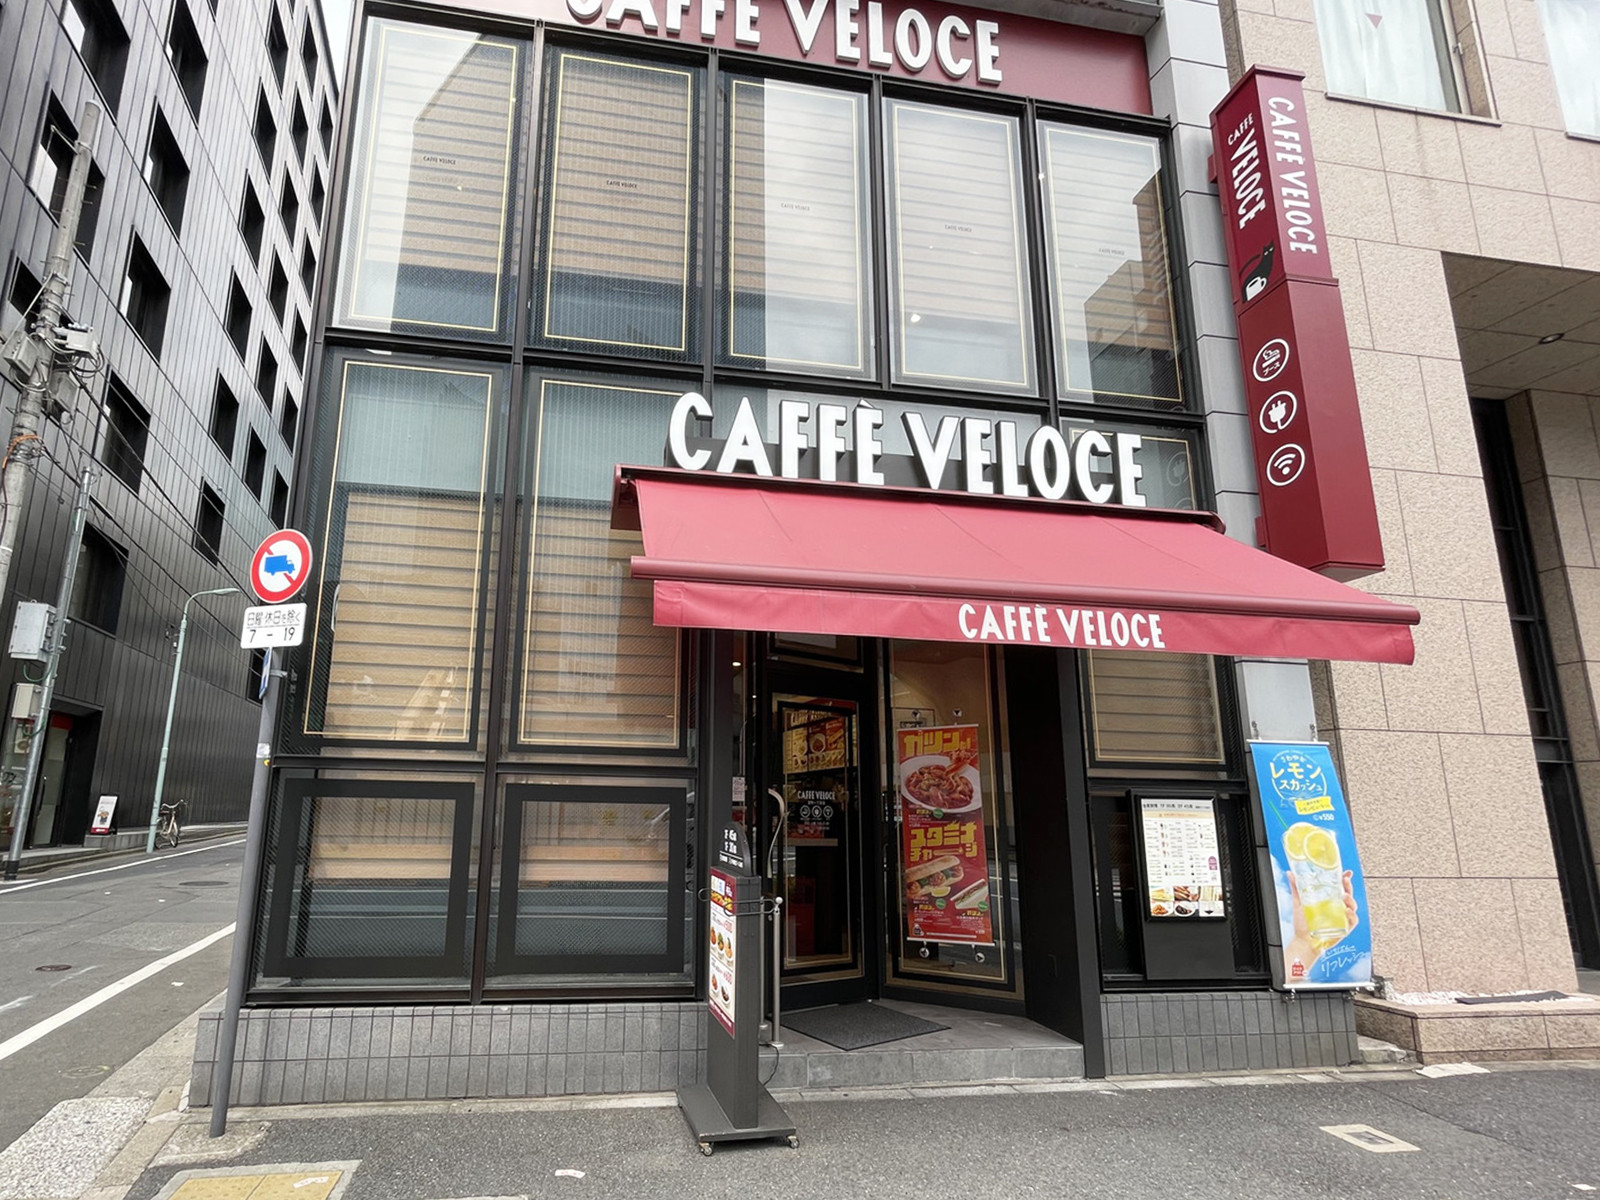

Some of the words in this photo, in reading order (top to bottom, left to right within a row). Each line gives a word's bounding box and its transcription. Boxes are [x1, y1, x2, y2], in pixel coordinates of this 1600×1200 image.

[784, 0, 1003, 86] VELOCE
[1230, 127, 1266, 230] VELOCE
[1279, 170, 1318, 255] VELOCE
[668, 392, 886, 487] CAFFÈ
[901, 410, 1148, 508] VELOCE
[249, 628, 257, 644] 7
[283, 626, 296, 642] 19
[1056, 608, 1166, 649] VELOCE
[1269, 762, 1322, 779] レモン
[1279, 779, 1323, 791] スカッシュ
[910, 820, 977, 848] スタミナ
